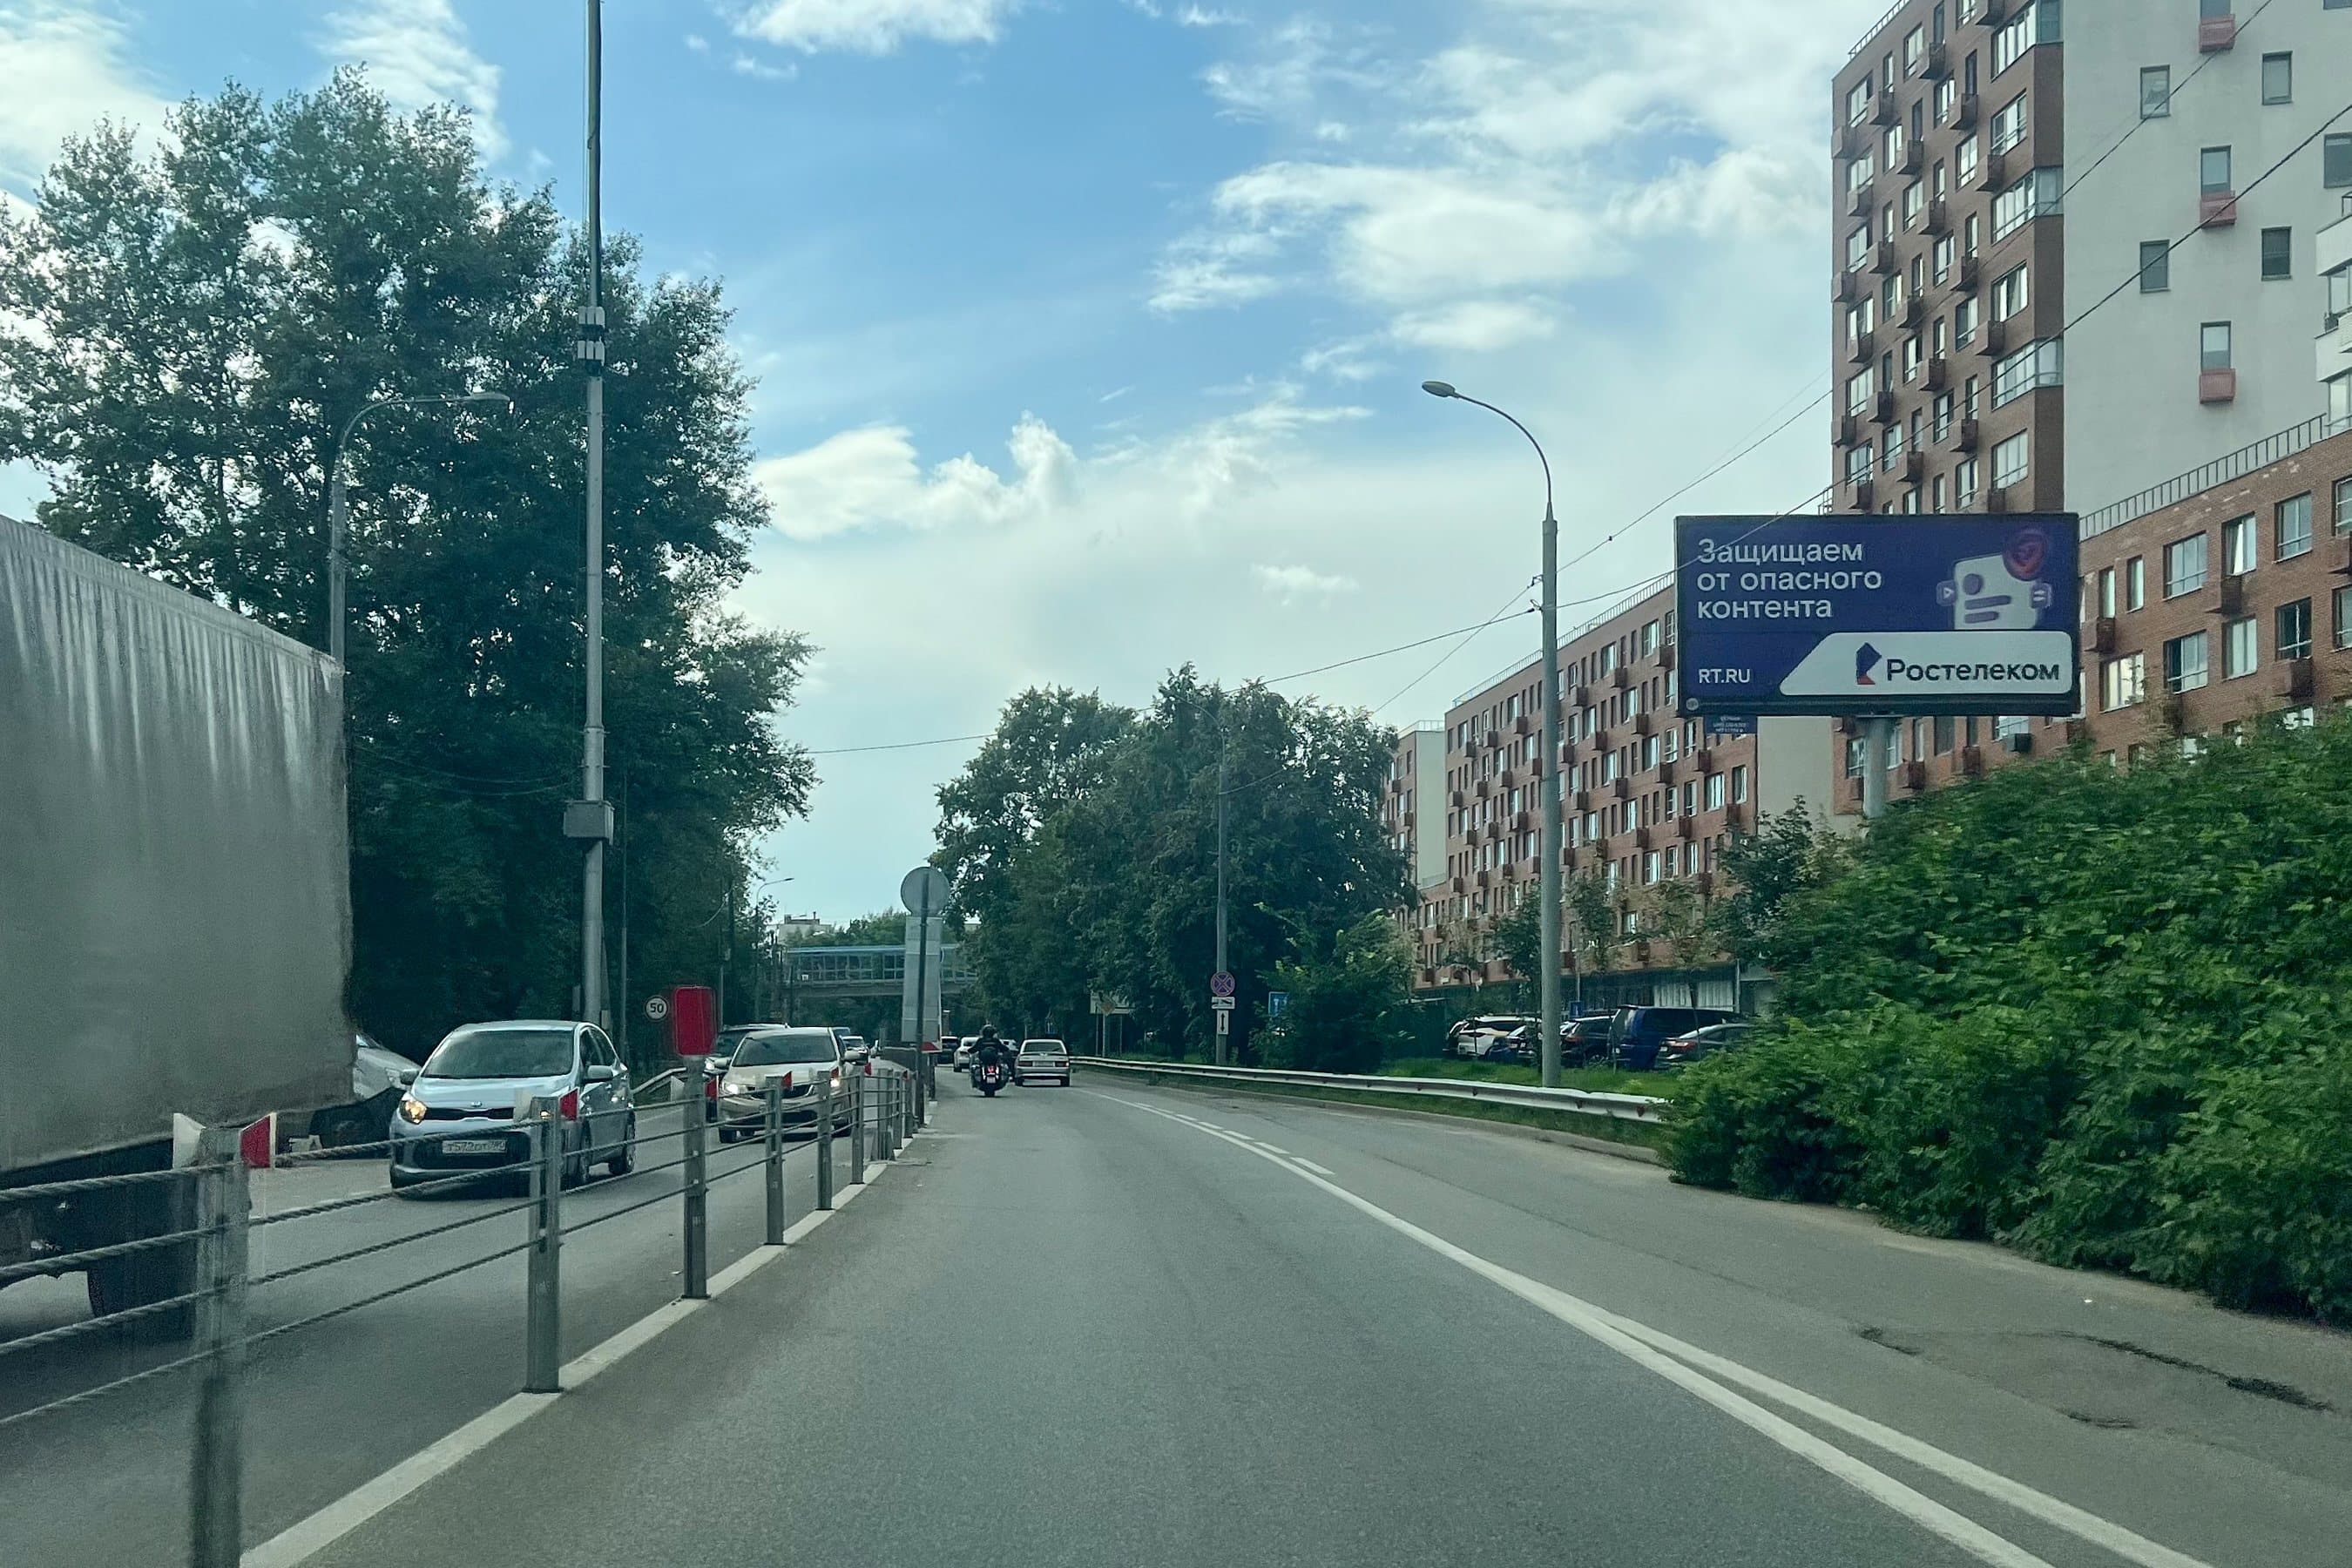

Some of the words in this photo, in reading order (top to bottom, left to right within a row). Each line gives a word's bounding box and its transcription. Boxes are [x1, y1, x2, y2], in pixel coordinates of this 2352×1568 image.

[1698, 538, 1862, 566] Защищаем
[1697, 572, 1731, 591] от
[1740, 571, 1882, 591] опасного
[1698, 598, 1833, 618] контента
[1698, 668, 1751, 684] RT.RU
[1887, 659, 2060, 681] Ростелеком
[650, 1003, 664, 1013] 50
